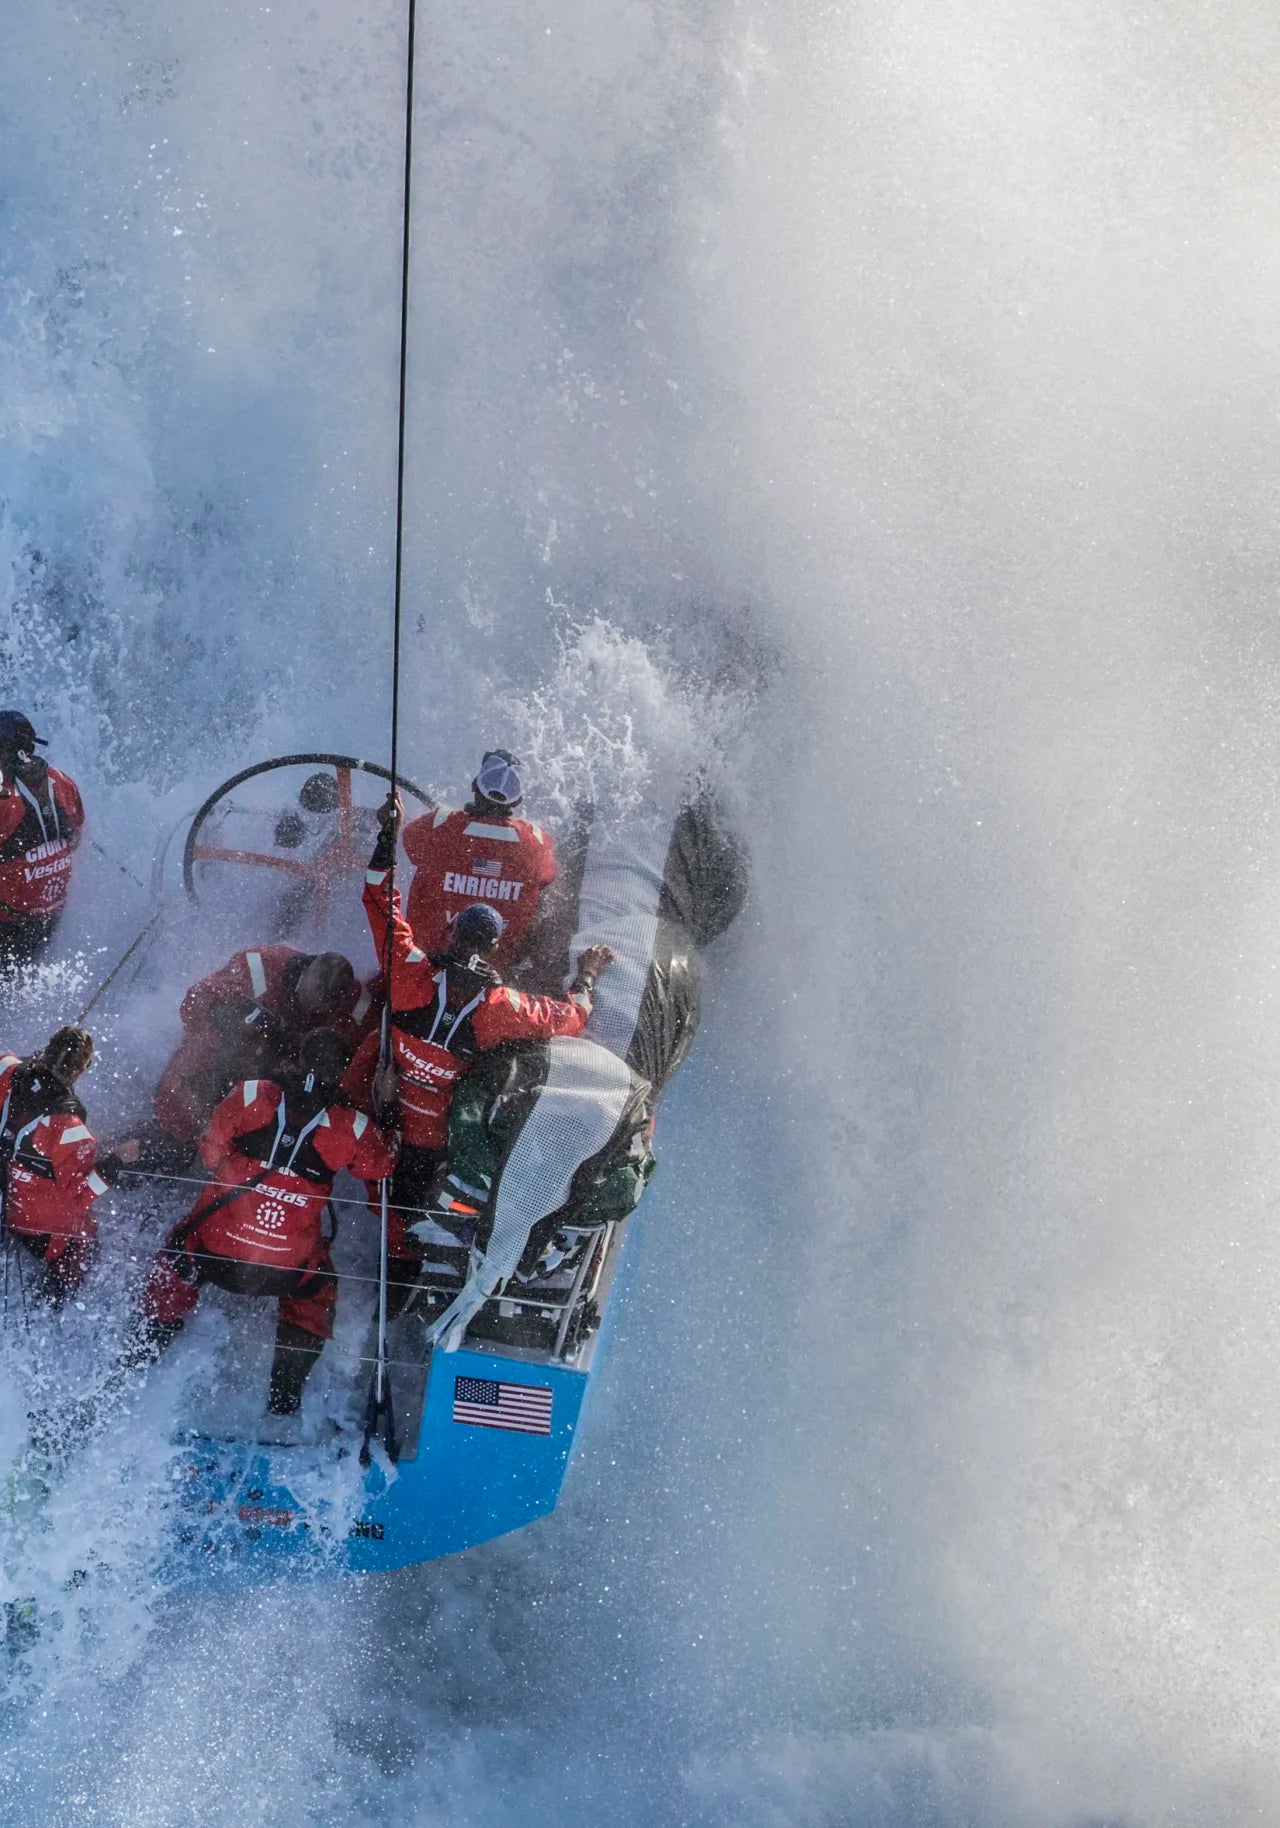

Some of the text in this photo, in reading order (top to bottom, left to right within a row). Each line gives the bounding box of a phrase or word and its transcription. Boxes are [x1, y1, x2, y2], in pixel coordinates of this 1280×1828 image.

[24, 853, 74, 882] Vestas
[443, 871, 524, 901] ENRIGHT
[399, 1039, 457, 1080] Vestas
[253, 1183, 308, 1208] estas
[263, 1208, 279, 1224] 11
